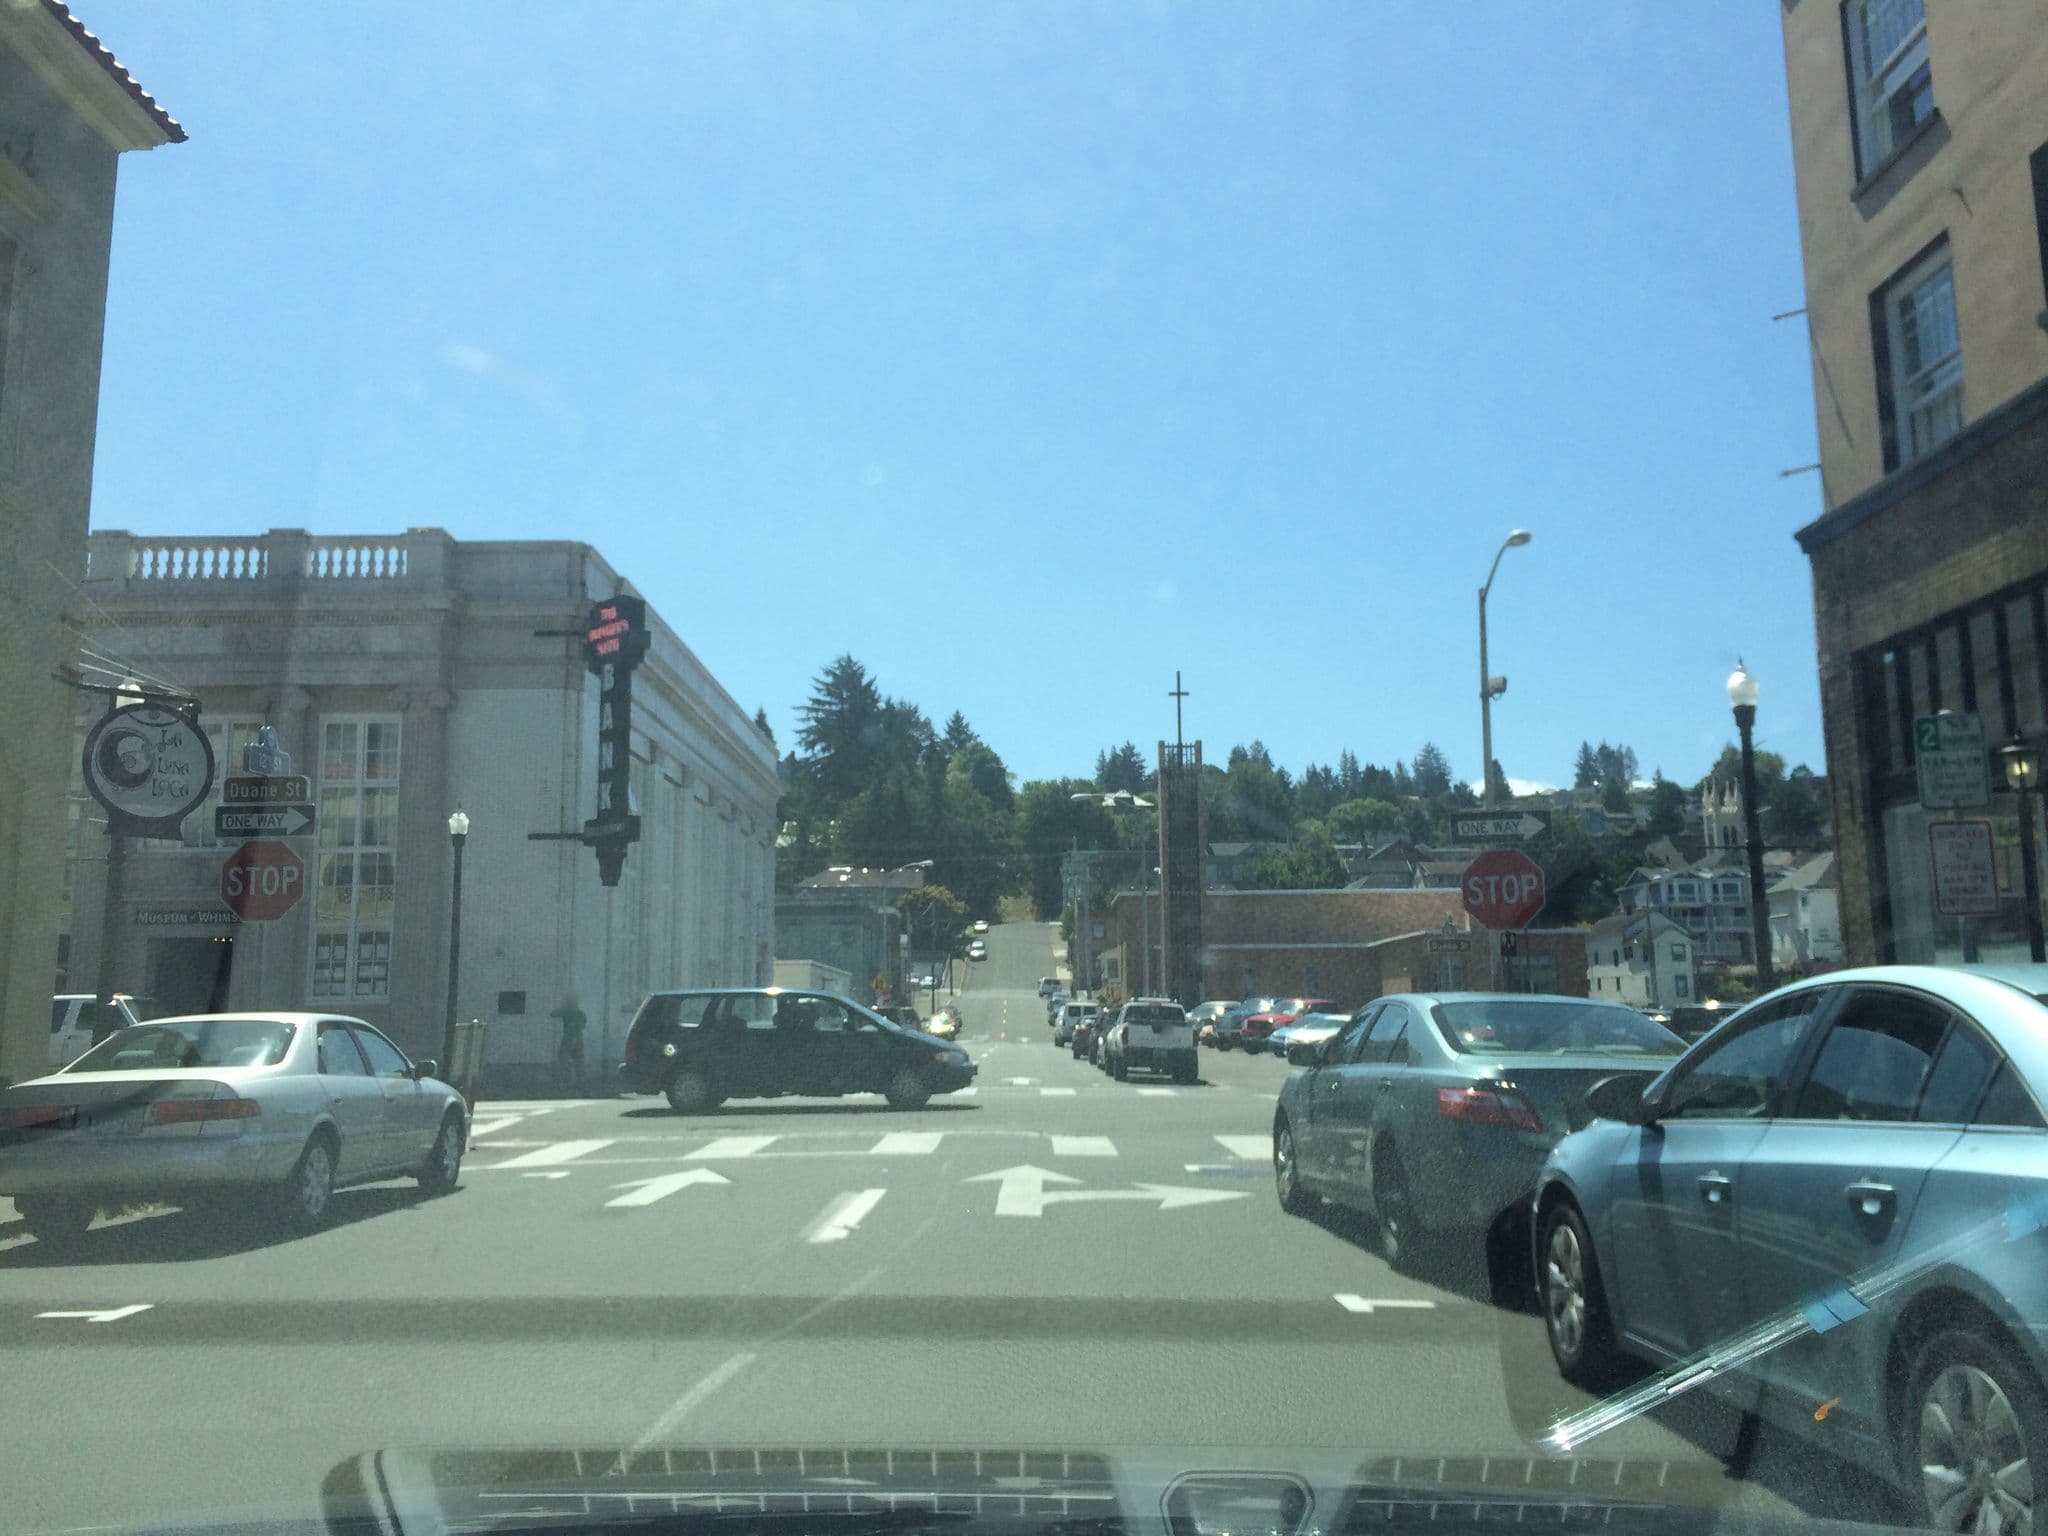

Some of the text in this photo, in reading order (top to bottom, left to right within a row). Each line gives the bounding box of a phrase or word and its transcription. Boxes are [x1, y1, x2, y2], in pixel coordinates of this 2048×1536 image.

[600, 663, 615, 810] BANK
[229, 782, 301, 799] Duane St
[225, 814, 285, 828] ONE WAY
[1461, 821, 1520, 834] ONE WAY
[226, 865, 299, 897] STOP
[1468, 874, 1538, 906] STOP
[137, 911, 188, 925] MUSEUM
[197, 911, 239, 924] WHIMS
